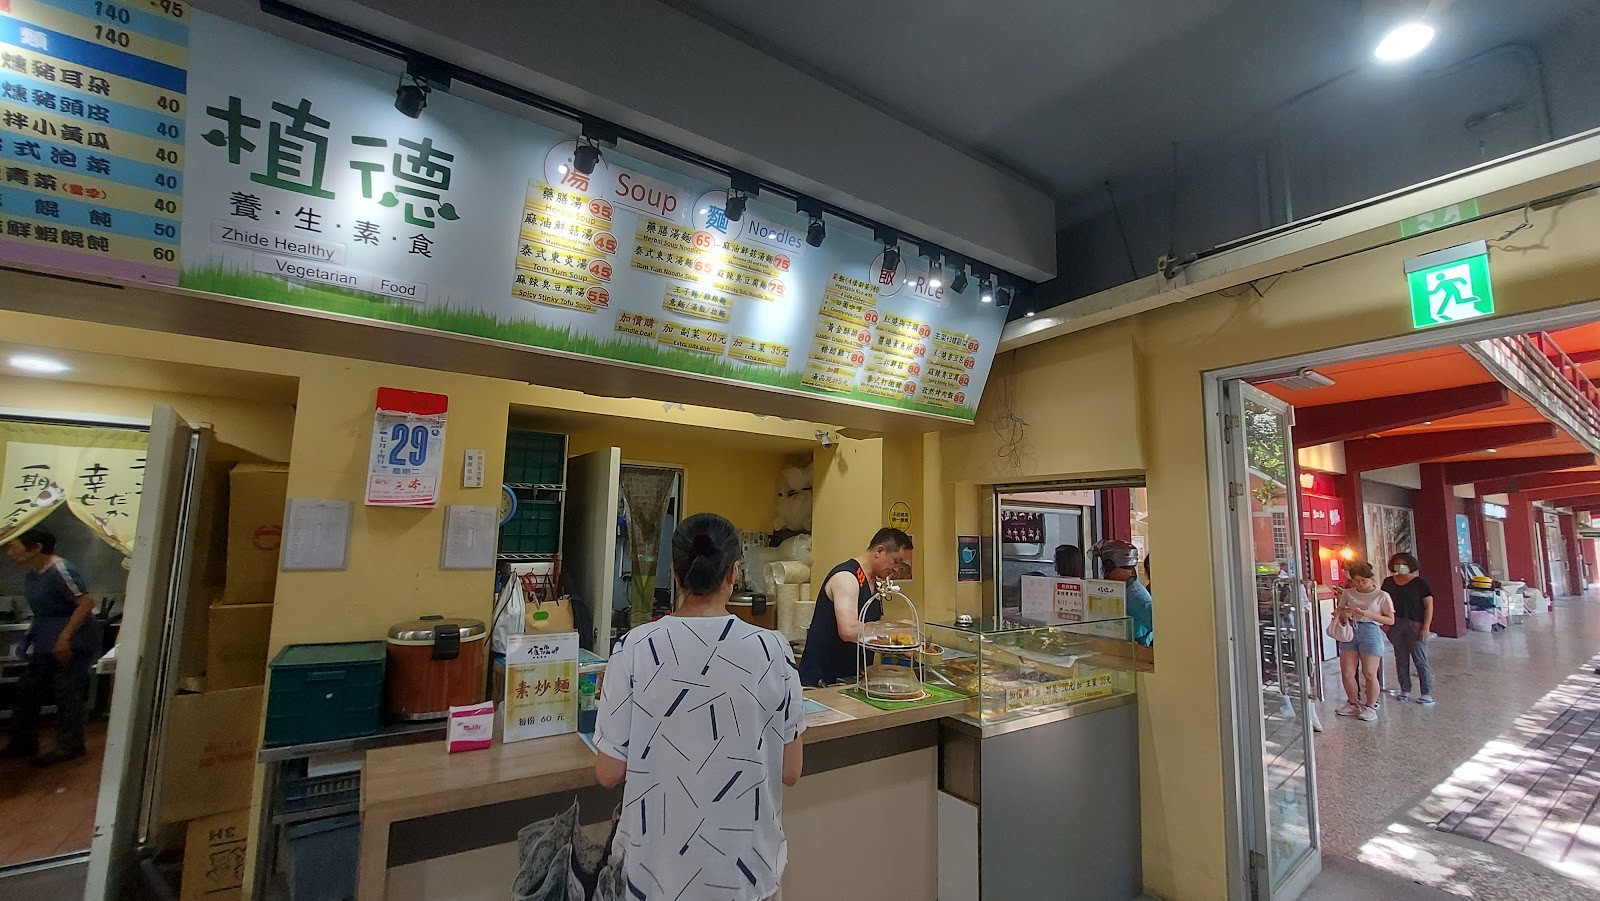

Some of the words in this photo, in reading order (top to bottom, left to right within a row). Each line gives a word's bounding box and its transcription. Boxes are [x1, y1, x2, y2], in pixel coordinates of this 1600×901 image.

[95, 2, 130, 25] 140
[95, 25, 130, 48] 140
[157, 95, 180, 113] 40
[156, 122, 179, 139] 40
[155, 148, 178, 165] 40
[200, 95, 461, 229] 植德
[155, 173, 177, 189] 40
[615, 172, 678, 215] Soup
[154, 199, 177, 214] 40
[542, 186, 583, 210] 藥膳湯
[589, 202, 612, 218] 35
[576, 213, 596, 225] Soup
[153, 222, 176, 239] 50
[646, 221, 693, 244] 藥膳湯麵
[696, 234, 712, 248] 65
[748, 221, 802, 250] Noodles
[221, 225, 269, 247] Zhide
[275, 236, 336, 261] Healthy
[595, 236, 616, 252] 45
[643, 234, 662, 245] Herbal
[664, 240, 678, 250] Soup
[153, 248, 175, 263] 60
[520, 243, 589, 270] 泰式東炎湯
[589, 264, 611, 279] 45
[774, 257, 790, 270] 75
[532, 263, 549, 273] Tom
[550, 266, 568, 276] Yum
[569, 271, 588, 282] Soup
[635, 262, 649, 270] Tom
[650, 265, 663, 274] Yum
[664, 268, 684, 279] Noodle
[693, 261, 713, 273] 65
[275, 259, 357, 286] Vegetarian
[381, 280, 416, 296] Food
[515, 274, 586, 298] 麻辣臭豆腐湯
[587, 291, 609, 303] 55
[769, 282, 785, 294] 75
[914, 276, 945, 300] Rice
[518, 289, 537, 300] Spicy
[538, 293, 559, 305] Stinky
[560, 299, 574, 307] Tofu
[575, 301, 592, 310] Soup
[864, 312, 878, 322] 80
[617, 325, 638, 336] Bundle
[639, 328, 653, 337] Deal
[662, 323, 673, 333] 加
[680, 327, 701, 339] 副菜
[706, 331, 727, 345] 20元
[857, 333, 871, 343] 80
[919, 328, 931, 337] 80
[673, 340, 689, 348] Extra
[732, 338, 743, 348] 加
[748, 340, 766, 353] 主菜
[770, 345, 789, 357] 35元
[913, 346, 926, 355] 80
[967, 342, 979, 351] 80
[850, 353, 864, 364] 80
[963, 359, 975, 368] 80
[908, 364, 919, 374] 80
[904, 383, 916, 393] 80
[958, 376, 970, 385] 80
[953, 394, 965, 403] 80
[389, 423, 429, 467] 29
[392, 467, 420, 475] 星期二
[515, 677, 571, 700] 素炒麵
[540, 714, 552, 723] 60
[556, 712, 566, 721] 元
